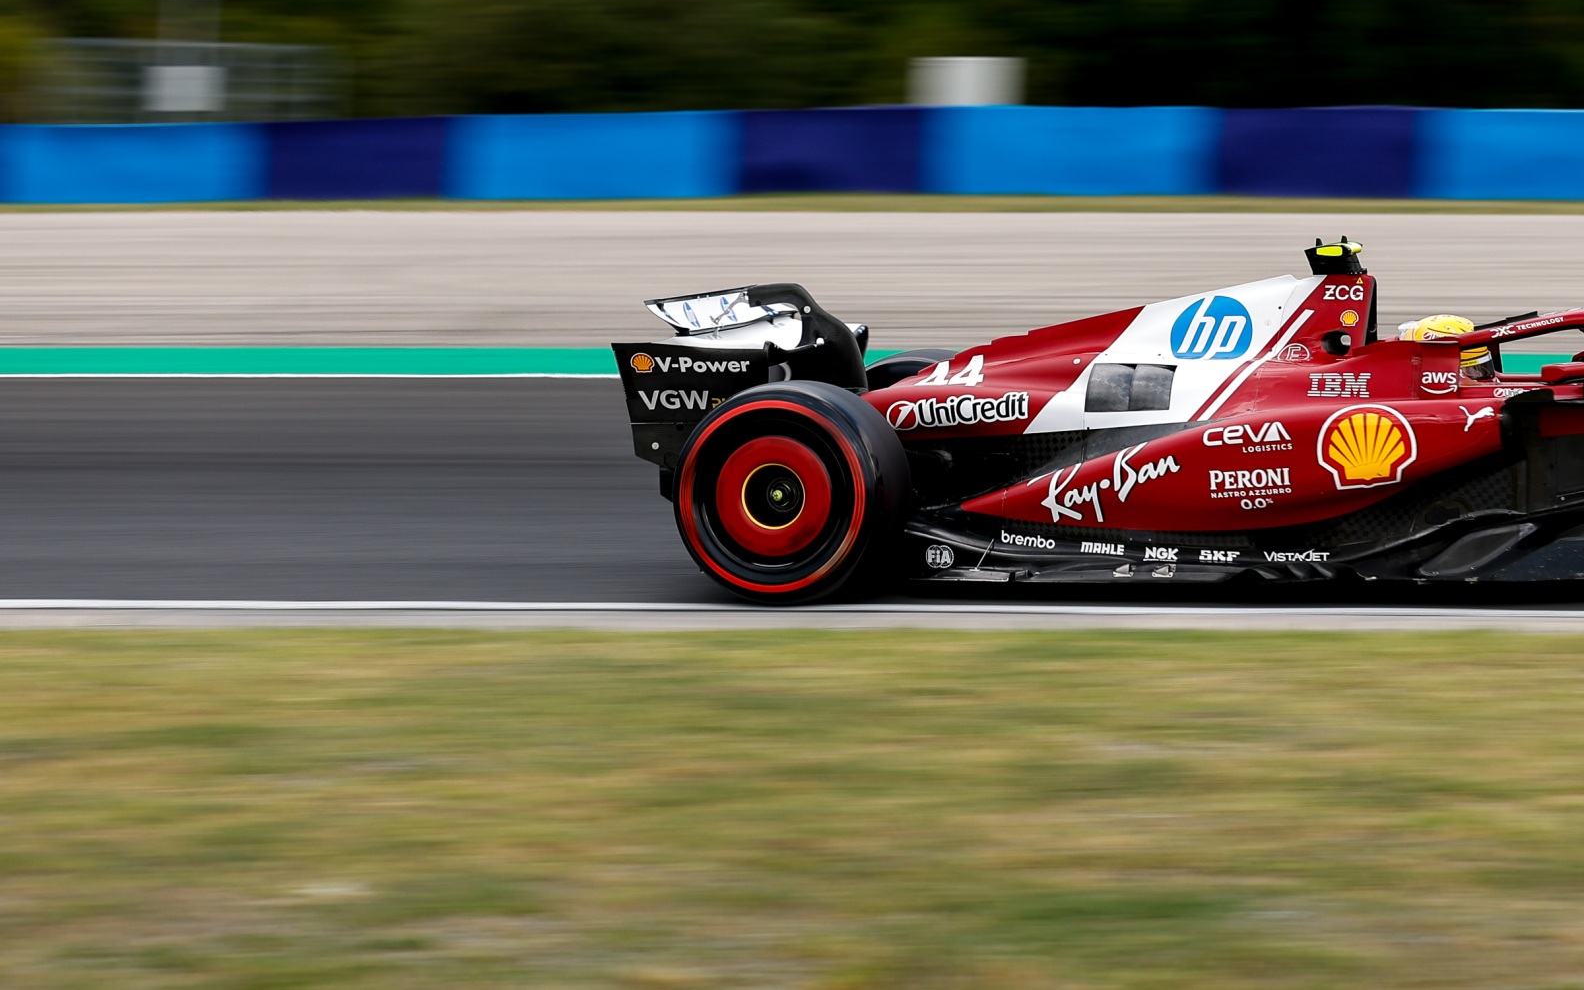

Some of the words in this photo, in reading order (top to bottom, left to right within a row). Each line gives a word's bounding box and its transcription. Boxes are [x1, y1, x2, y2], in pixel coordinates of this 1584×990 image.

[1176, 297, 1248, 359] hp
[1516, 316, 1564, 330] TECHNOLOGY
[655, 356, 751, 373] V-Power
[915, 355, 984, 387] 44
[1307, 373, 1370, 398] IBM
[1421, 371, 1458, 384] aws
[638, 389, 709, 411] VGW
[917, 391, 1030, 428] UniCredit
[1242, 443, 1293, 453] LOGISTICS
[1209, 468, 1291, 490] PERONI
[1210, 491, 1247, 499] NASTRO
[1248, 488, 1292, 497] AZZURRO
[1001, 530, 1056, 550] brembo
[1080, 541, 1125, 556] MAHLE
[1144, 547, 1179, 561] NGK
[1199, 550, 1241, 562] SKF
